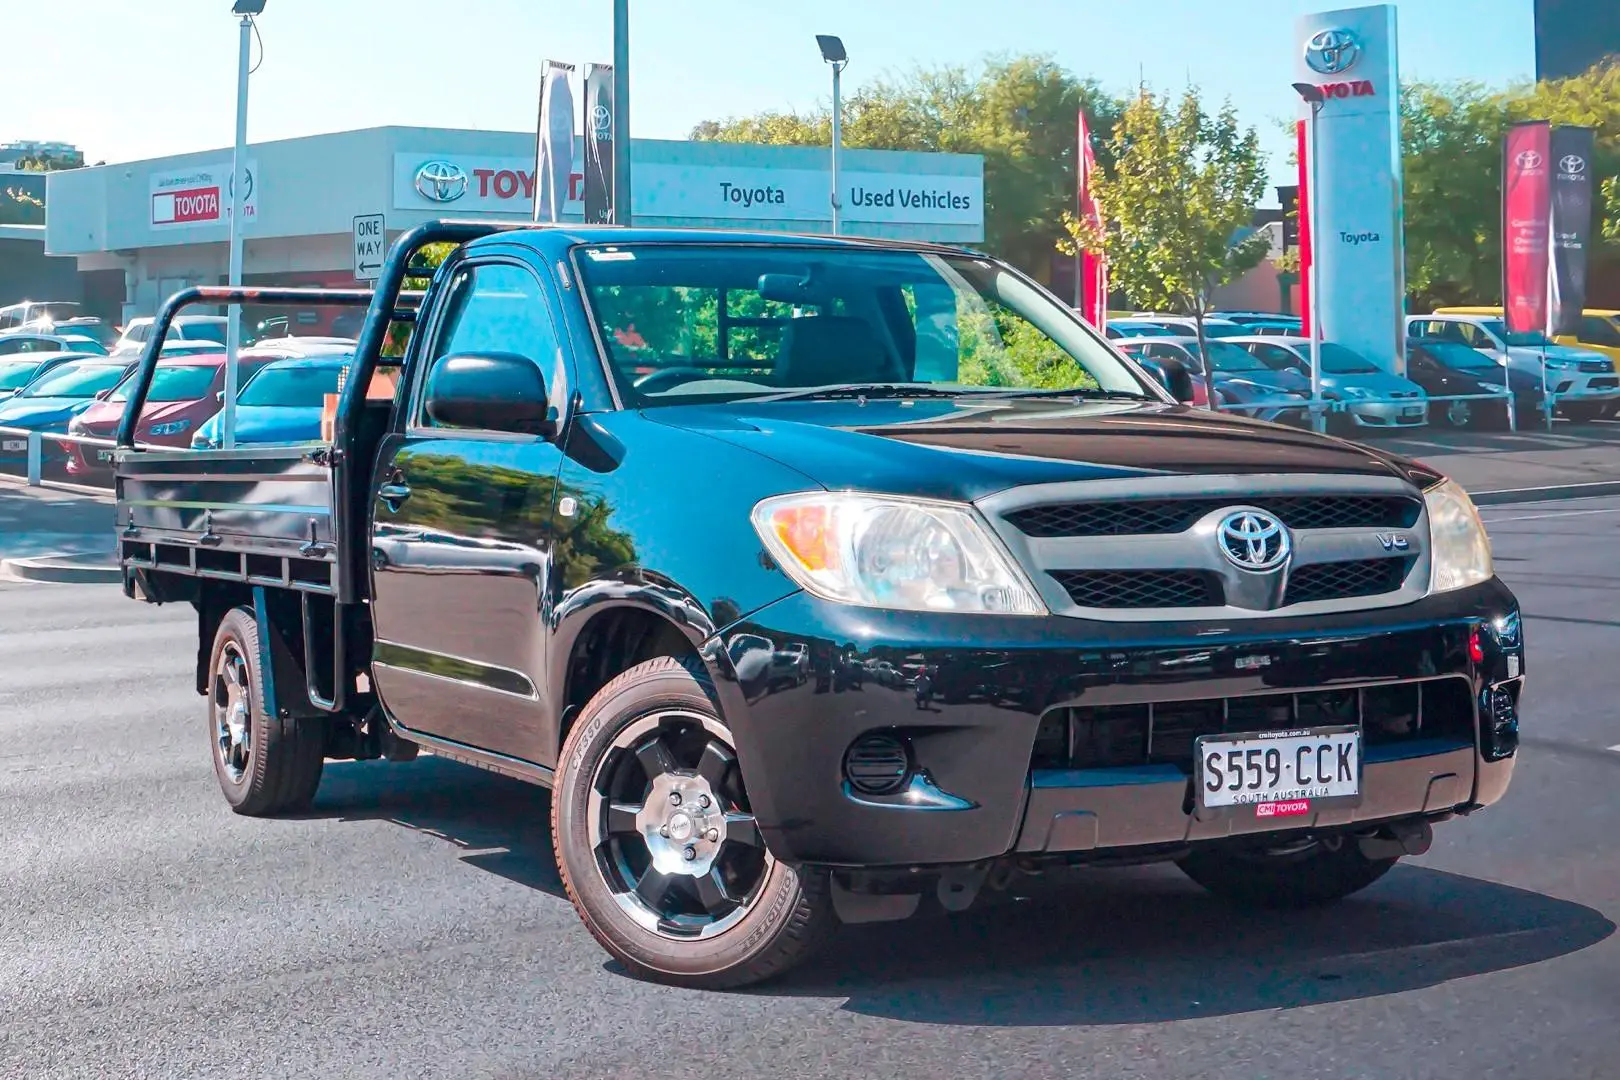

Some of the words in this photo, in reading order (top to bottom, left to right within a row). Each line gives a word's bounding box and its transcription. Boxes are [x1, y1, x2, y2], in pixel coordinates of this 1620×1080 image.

[473, 169, 586, 201] TOYT
[720, 182, 785, 207] Toyota
[851, 187, 895, 207] Used
[899, 189, 971, 209] Vehicles
[175, 193, 218, 216] TOYOTA
[358, 220, 380, 236] ONE
[1339, 231, 1380, 246] Toyota
[357, 240, 381, 256] WAY
[1376, 533, 1409, 551] V6
[1233, 793, 1268, 805] SOUTH
[1273, 787, 1330, 800] AUSTRALIA
[1256, 803, 1276, 816] CMI
[1276, 802, 1308, 813] TOYOTA
